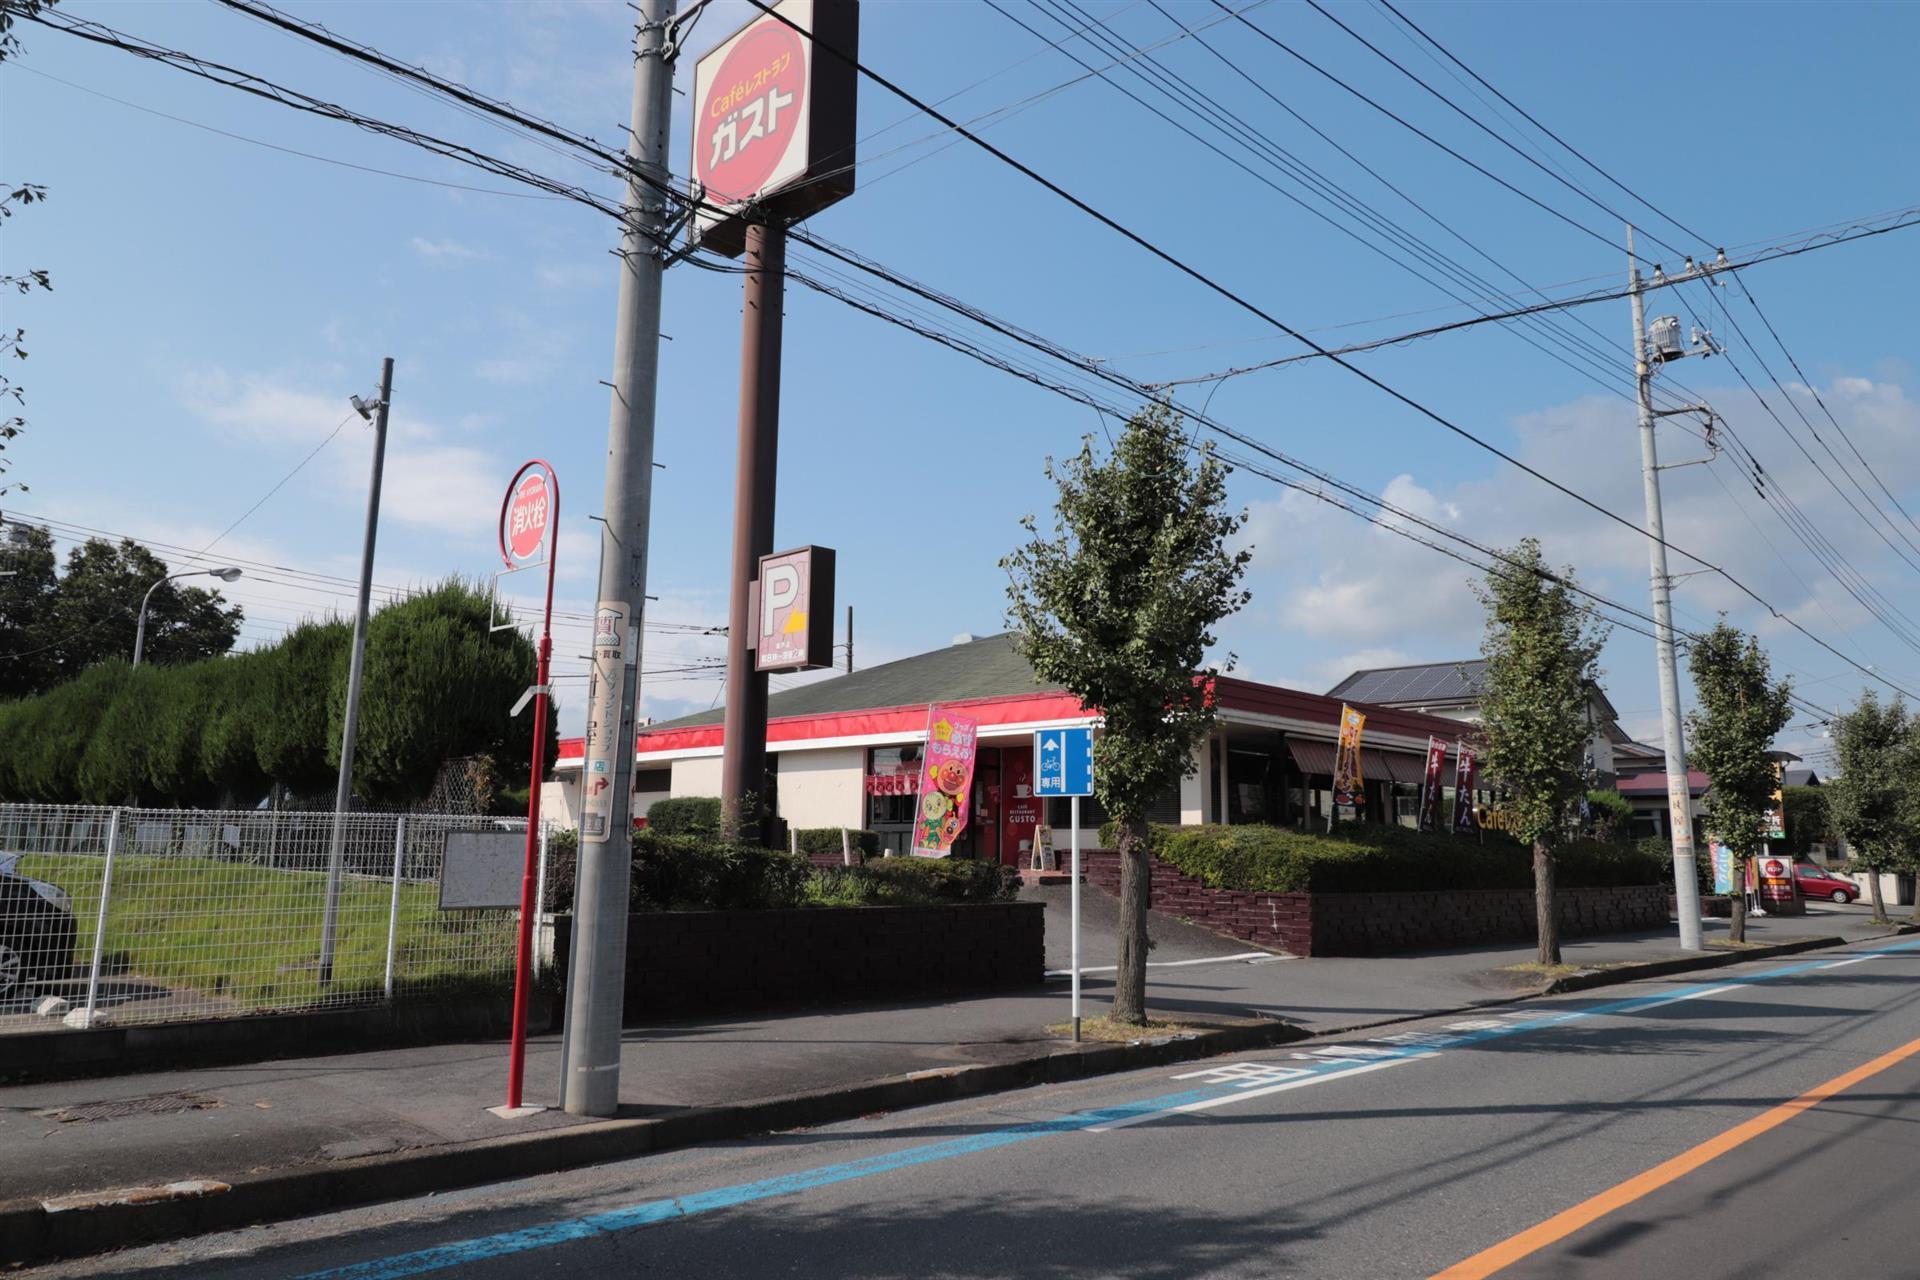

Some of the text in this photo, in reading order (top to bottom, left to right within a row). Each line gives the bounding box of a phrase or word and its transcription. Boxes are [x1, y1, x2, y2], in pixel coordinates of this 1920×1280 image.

[711, 51, 791, 117] Caféレストラン
[710, 87, 793, 170] ガスト
[512, 496, 546, 536] 消火栓
[764, 564, 799, 637] P
[1040, 776, 1061, 788] 専用
[1424, 750, 1439, 825] 牛たん
[1459, 756, 1471, 826] 牛たん
[1009, 815, 1036, 823] GUSTO
